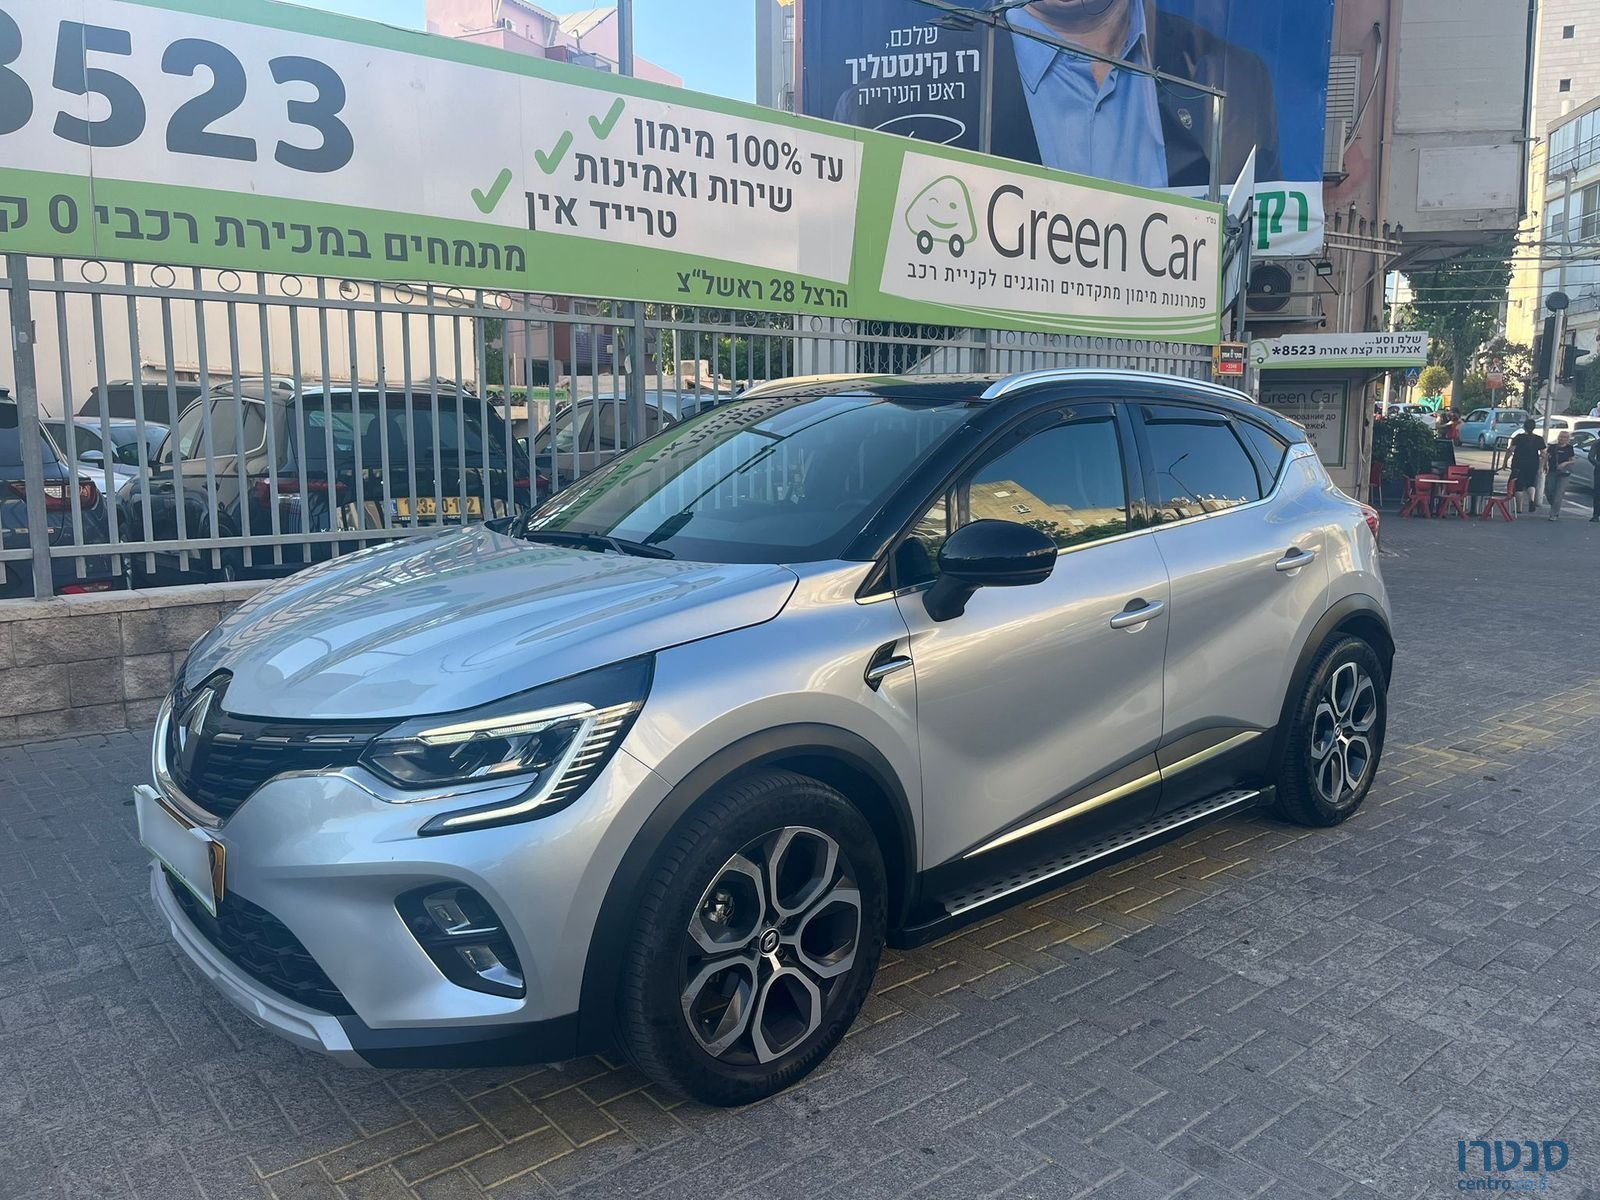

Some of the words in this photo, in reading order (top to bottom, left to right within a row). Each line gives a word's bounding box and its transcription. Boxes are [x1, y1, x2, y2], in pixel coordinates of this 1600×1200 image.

[886, 26, 938, 48] שלכם,
[845, 51, 948, 84] קינסטליך
[956, 49, 980, 72] רז
[859, 83, 921, 105] העירייה
[927, 82, 965, 101] ראש
[634, 118, 715, 159] מימון
[726, 132, 802, 175] 100%
[574, 153, 697, 198] ואמינות
[811, 153, 843, 182] עד
[708, 175, 793, 212] שירות
[49, 194, 79, 234] 0
[525, 192, 578, 230] אין
[589, 200, 677, 238] טרייד
[1255, 191, 1309, 250] רק
[95, 205, 199, 244] רכבי
[987, 184, 1127, 273] Green
[1140, 212, 1206, 282] Car
[214, 215, 372, 259] במכירת
[384, 232, 526, 272] מתמחים
[907, 262, 937, 280] רכב
[944, 267, 997, 289] לקניית
[769, 279, 795, 302] 28
[801, 280, 848, 308] הרצל
[1004, 276, 1055, 293] והוגנים
[1061, 281, 1121, 303] מתקדמים
[1126, 287, 1157, 304] מימון
[1161, 291, 1206, 309] פתרונות
[1320, 347, 1348, 355] אחרת
[1350, 346, 1373, 356] קצת
[1365, 336, 1395, 345] וסע...
[1376, 345, 1388, 354] זה
[1390, 345, 1422, 355] אצלנו
[1397, 335, 1422, 345] שלם
[1259, 389, 1306, 404] Green
[1310, 388, 1338, 404] Car
[1325, 413, 1337, 422] до
